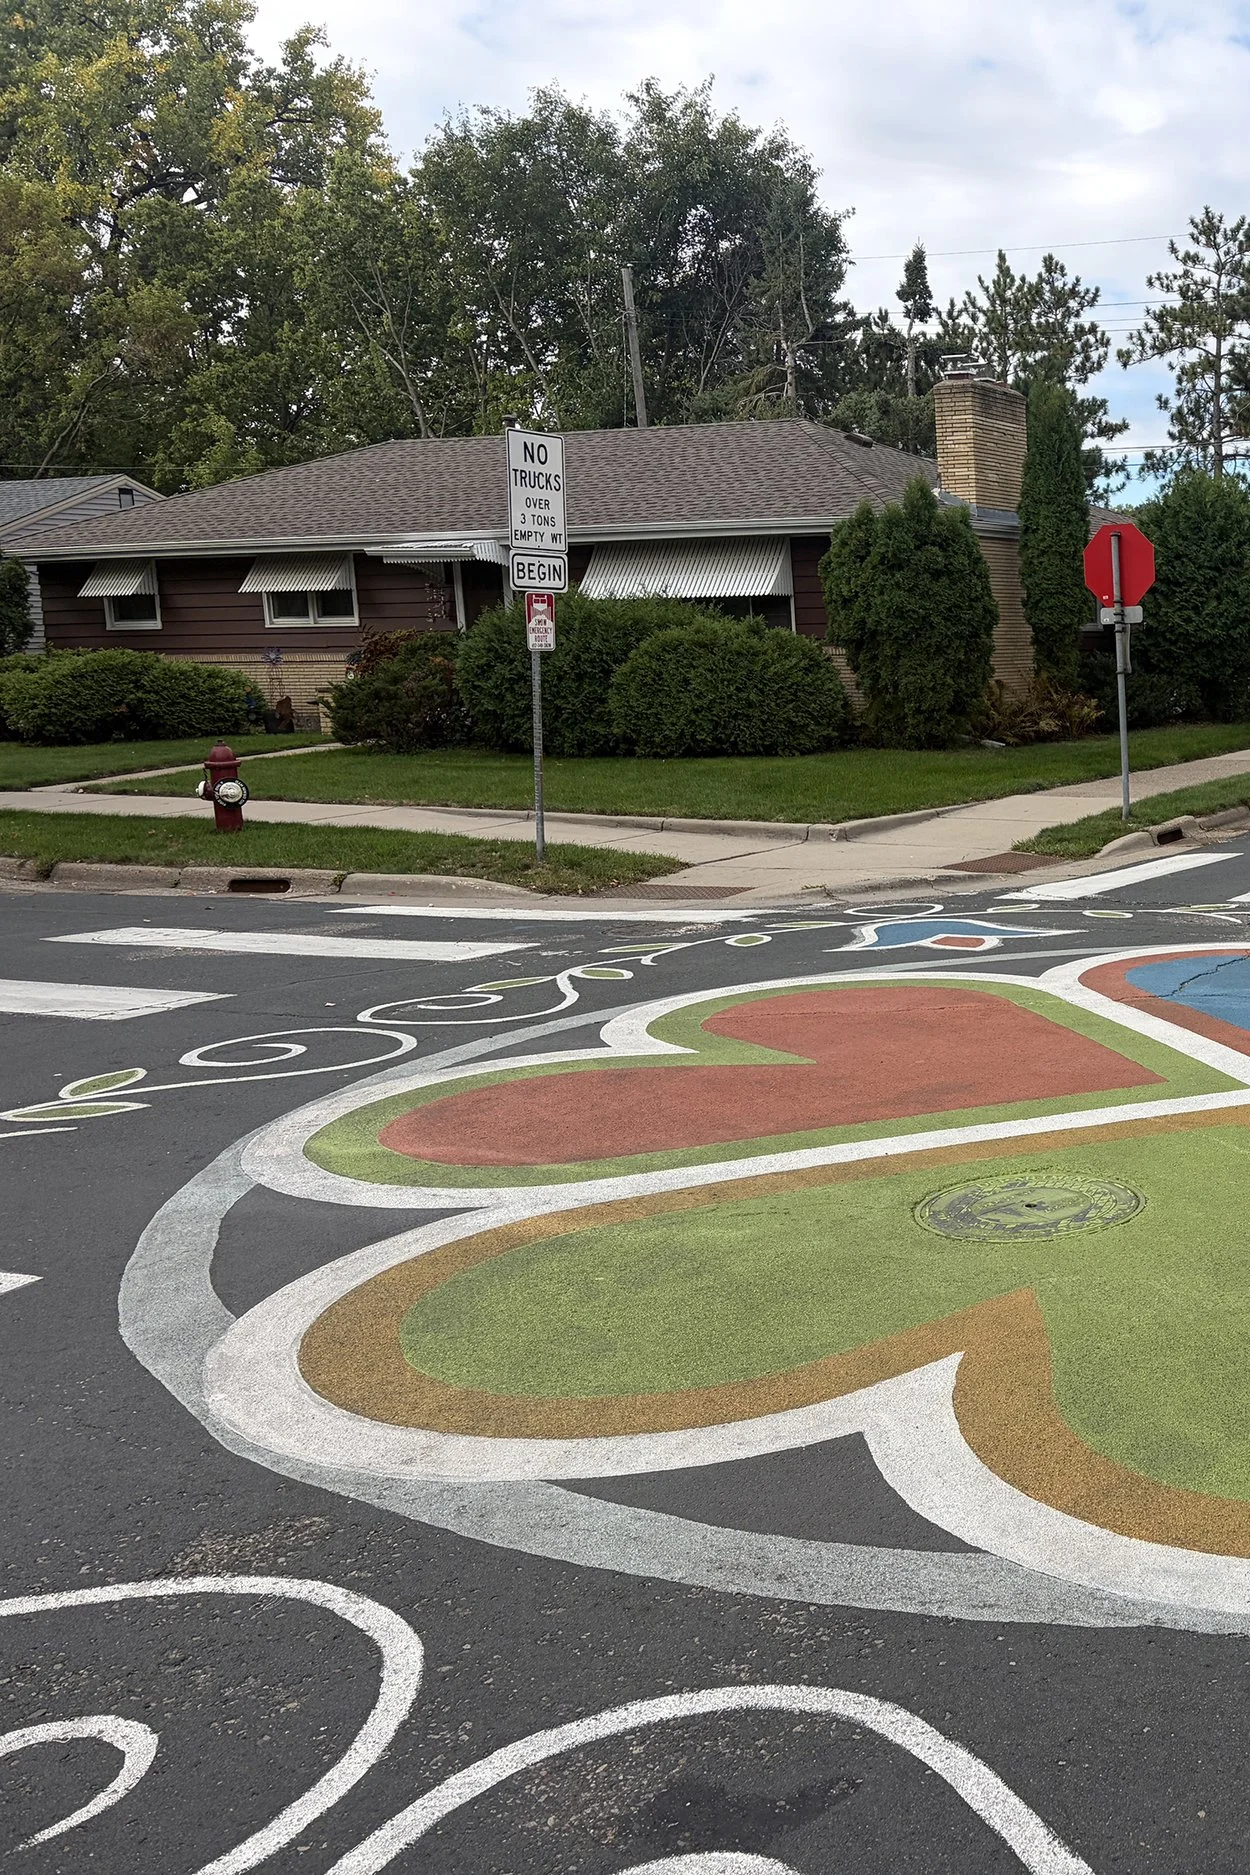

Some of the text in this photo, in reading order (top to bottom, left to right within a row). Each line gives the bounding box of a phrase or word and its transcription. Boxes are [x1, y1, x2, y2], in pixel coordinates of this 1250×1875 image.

[523, 441, 548, 465] NO
[512, 468, 562, 492] TRUCKS
[525, 497, 550, 510] OVER
[520, 513, 556, 527] 3 TONS
[514, 529, 563, 545] EMPTY WT
[516, 562, 562, 582] BEGIN
